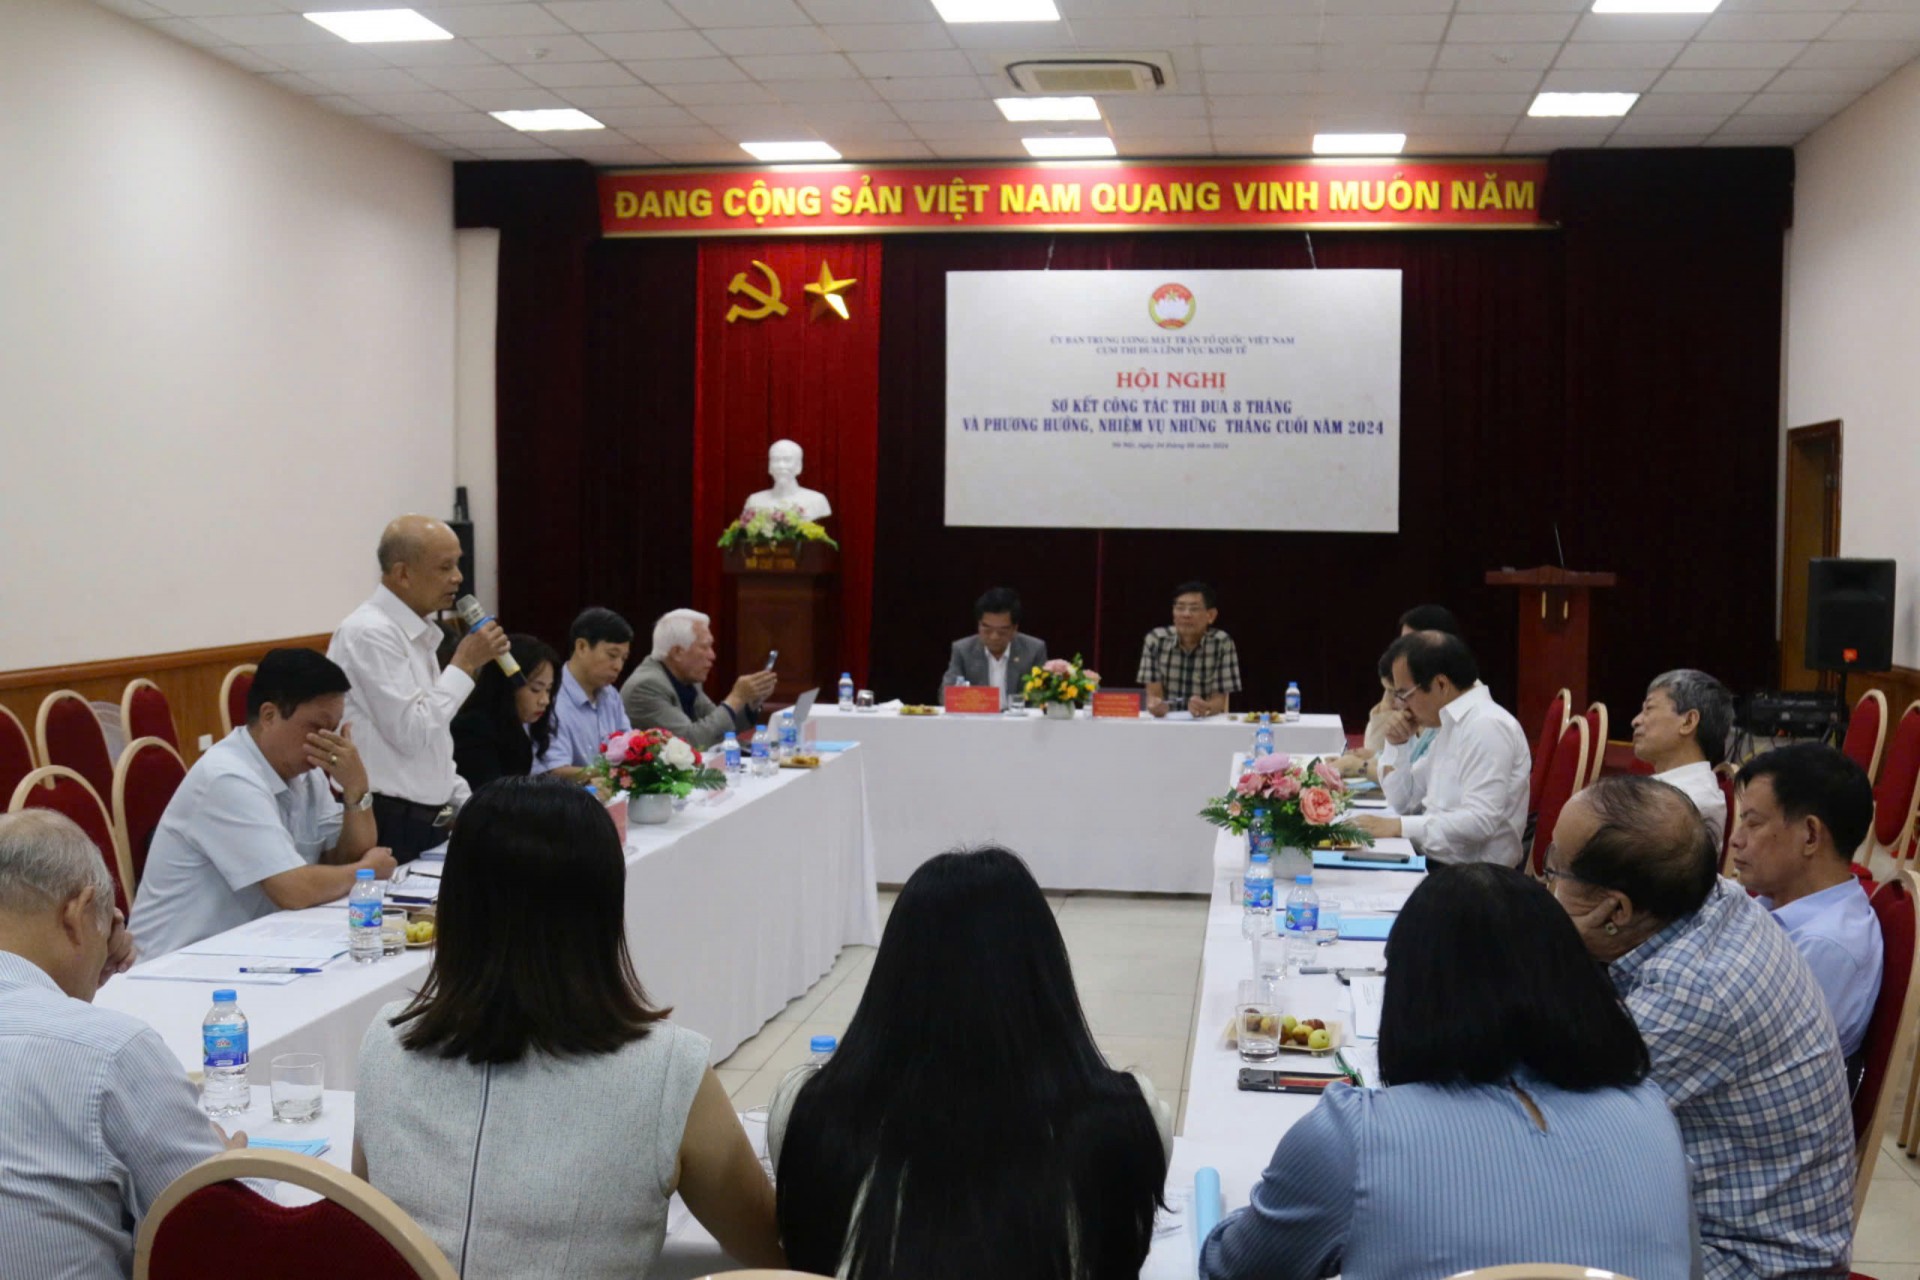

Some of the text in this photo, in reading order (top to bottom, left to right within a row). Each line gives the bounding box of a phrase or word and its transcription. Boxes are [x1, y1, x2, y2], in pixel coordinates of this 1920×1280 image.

[723, 179, 822, 224] CỘNG
[831, 175, 903, 215] SẢN
[914, 177, 990, 221] VIỆT
[1000, 183, 1082, 213] NAM
[1090, 182, 1221, 214] QUANG
[1233, 181, 1319, 212] VINH
[1451, 172, 1535, 211] NĂM
[1116, 367, 1226, 394] HỘI NGHỊ
[1073, 395, 1099, 413] KẾT
[1103, 396, 1138, 413] CÔNG
[1143, 396, 1168, 414] TÁC
[1173, 399, 1196, 414] THI
[1201, 399, 1228, 414] ĐUA
[1232, 399, 1242, 414] 8
[1246, 396, 1293, 414] THÁNG
[962, 415, 979, 432] VÀ
[984, 416, 1039, 432] PHƯƠNG
[1099, 415, 1143, 434] NHIỆM
[1148, 418, 1165, 435] VỤ
[1170, 415, 1217, 433] NHỮNG
[1226, 415, 1272, 434] THÁNG
[1276, 414, 1309, 435] CUỐI
[1313, 416, 1343, 435] NĂM
[1348, 420, 1385, 435] 2024
